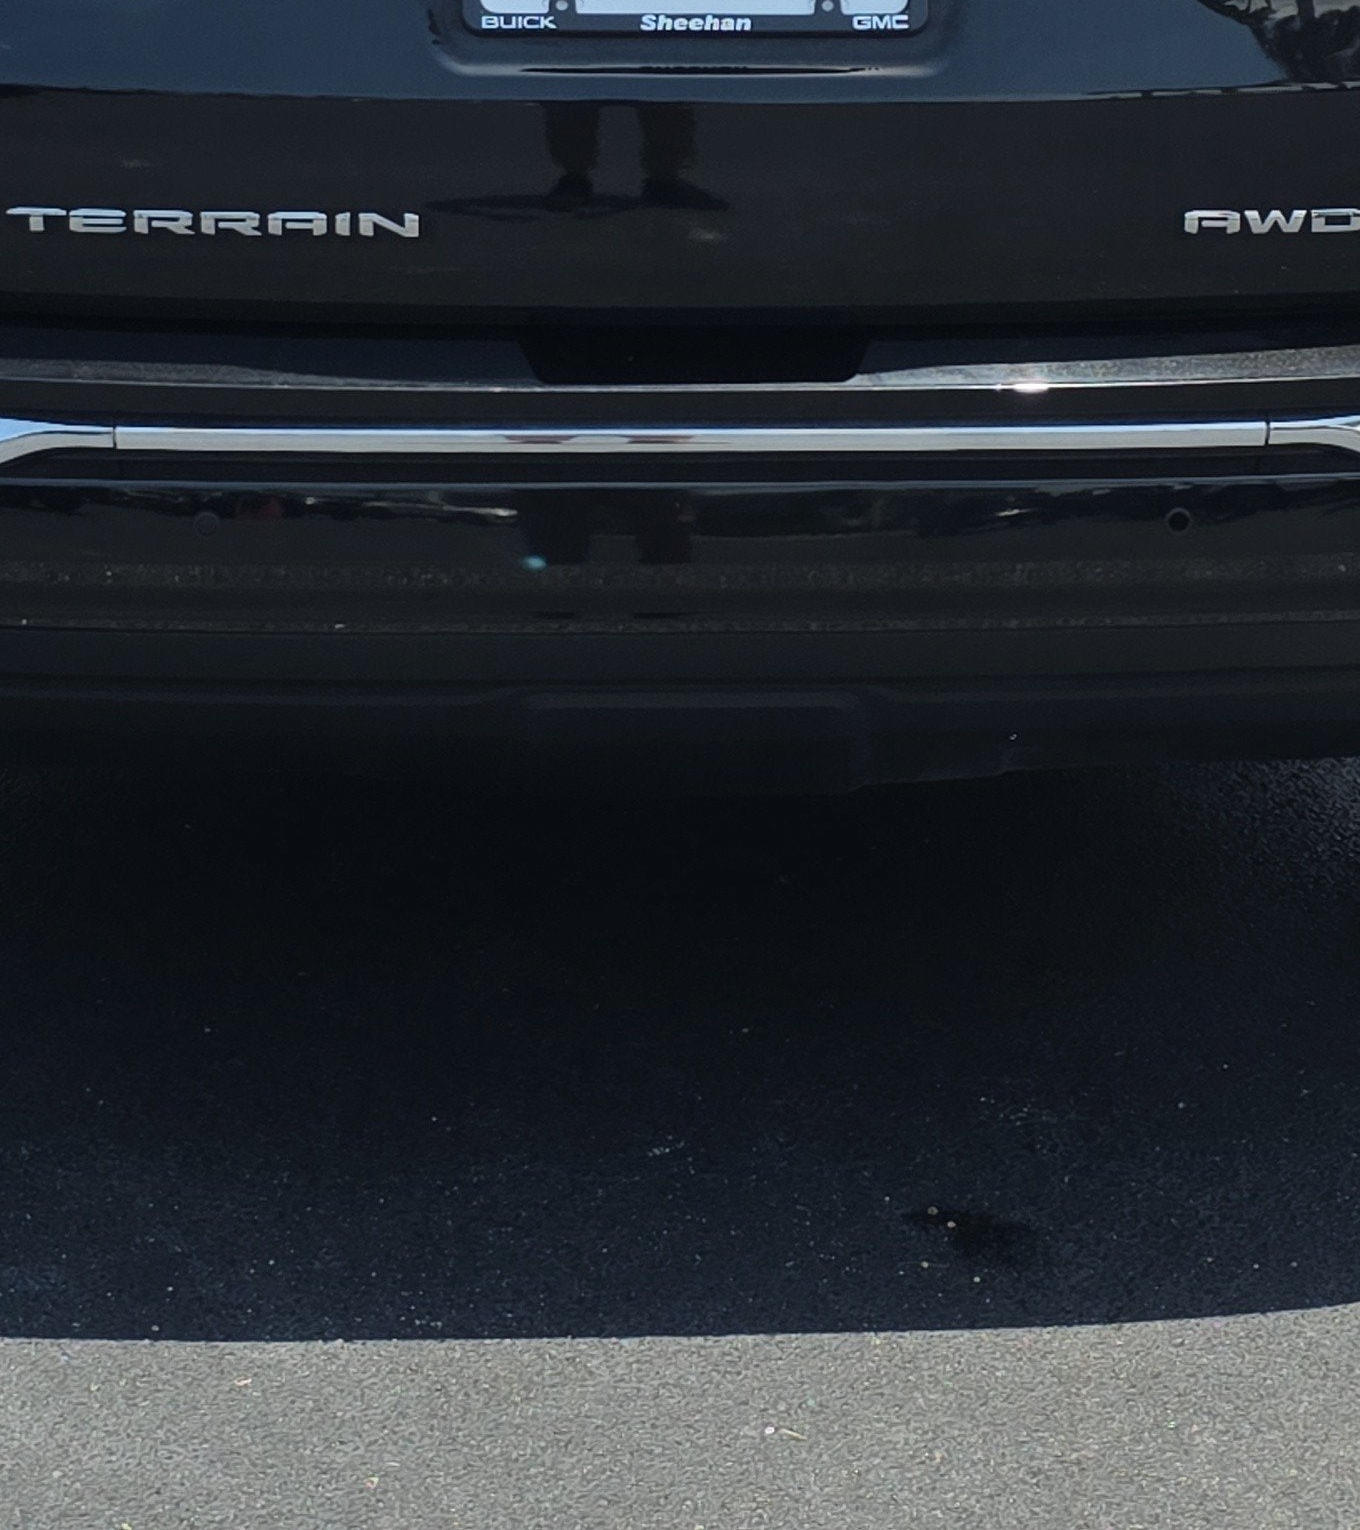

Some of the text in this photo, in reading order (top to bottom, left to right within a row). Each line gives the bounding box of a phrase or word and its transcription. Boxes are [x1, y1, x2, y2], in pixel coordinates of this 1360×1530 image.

[481, 16, 557, 29] BUICK
[640, 15, 752, 31] Sheehan
[852, 15, 909, 29] GMC
[6, 206, 420, 238] TERRAIN
